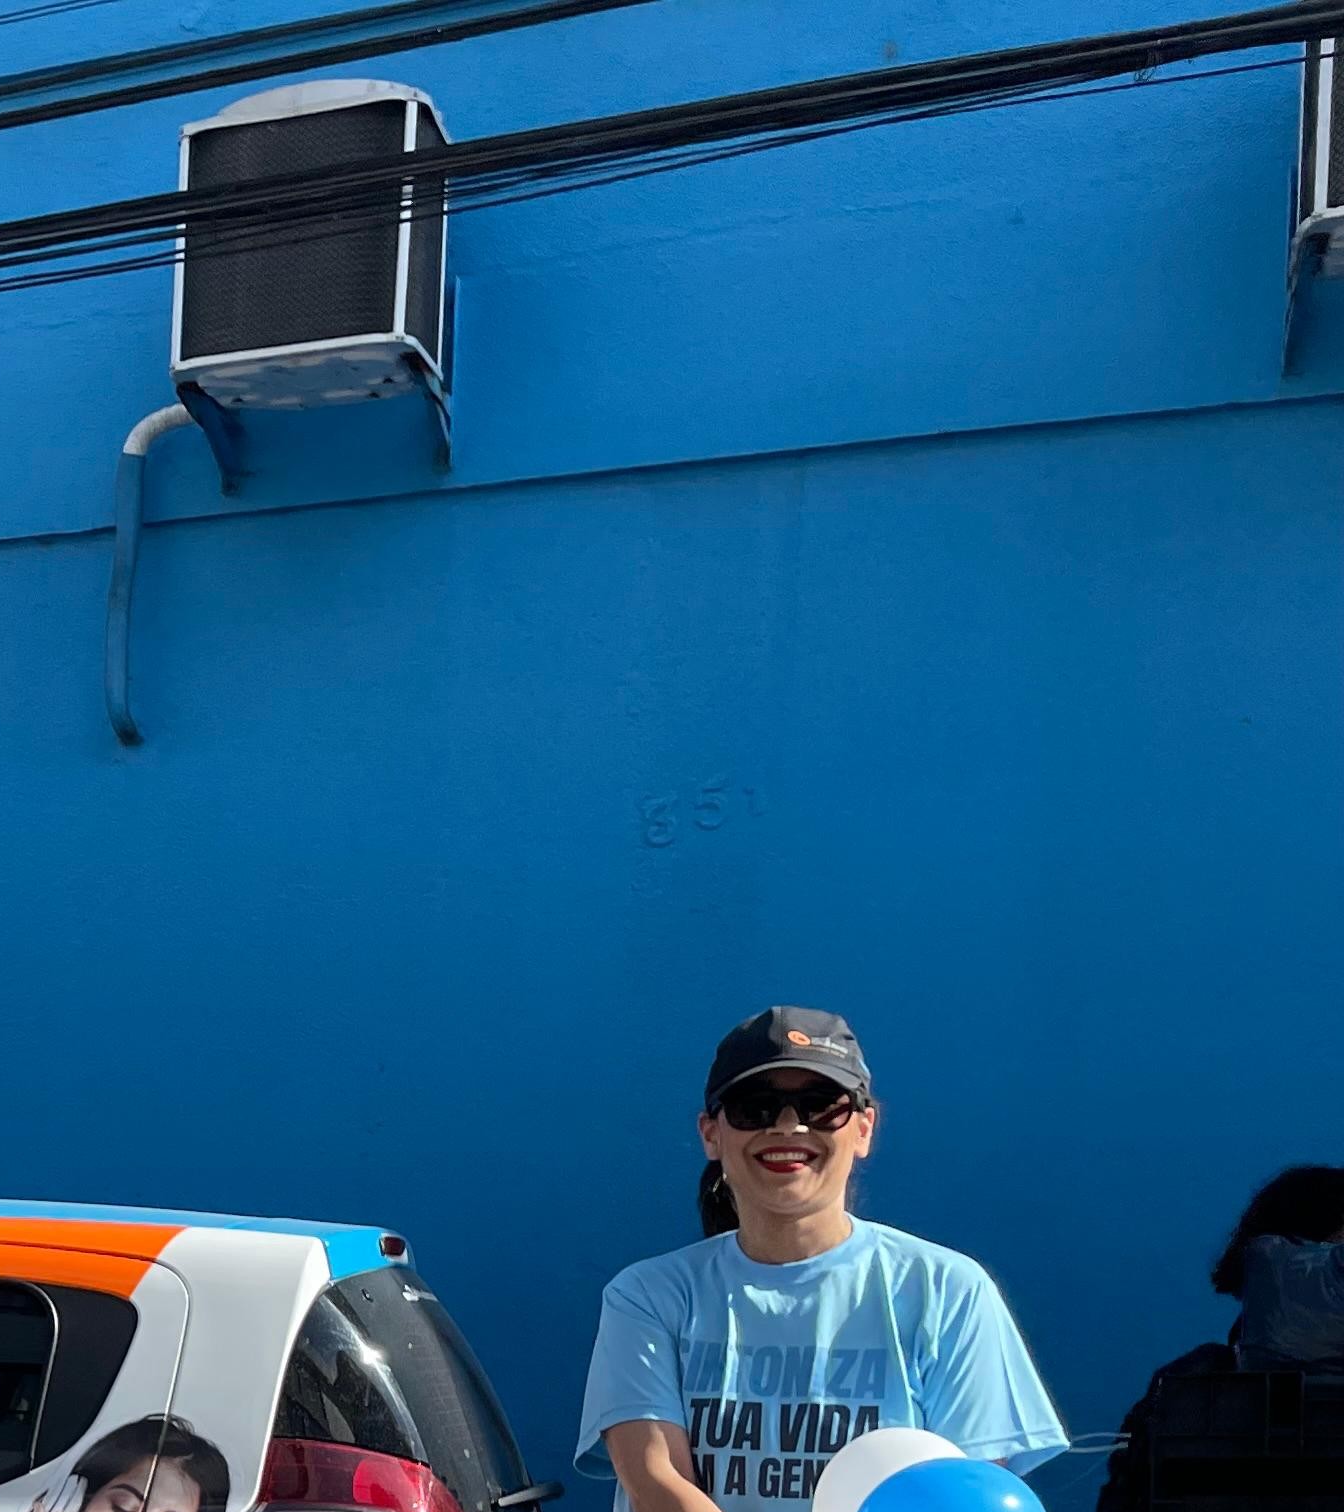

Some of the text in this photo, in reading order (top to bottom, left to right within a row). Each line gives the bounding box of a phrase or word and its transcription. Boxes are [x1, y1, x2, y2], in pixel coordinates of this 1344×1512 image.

[690, 1397, 880, 1454] TUA VIDA
[724, 1455, 746, 1496] A
